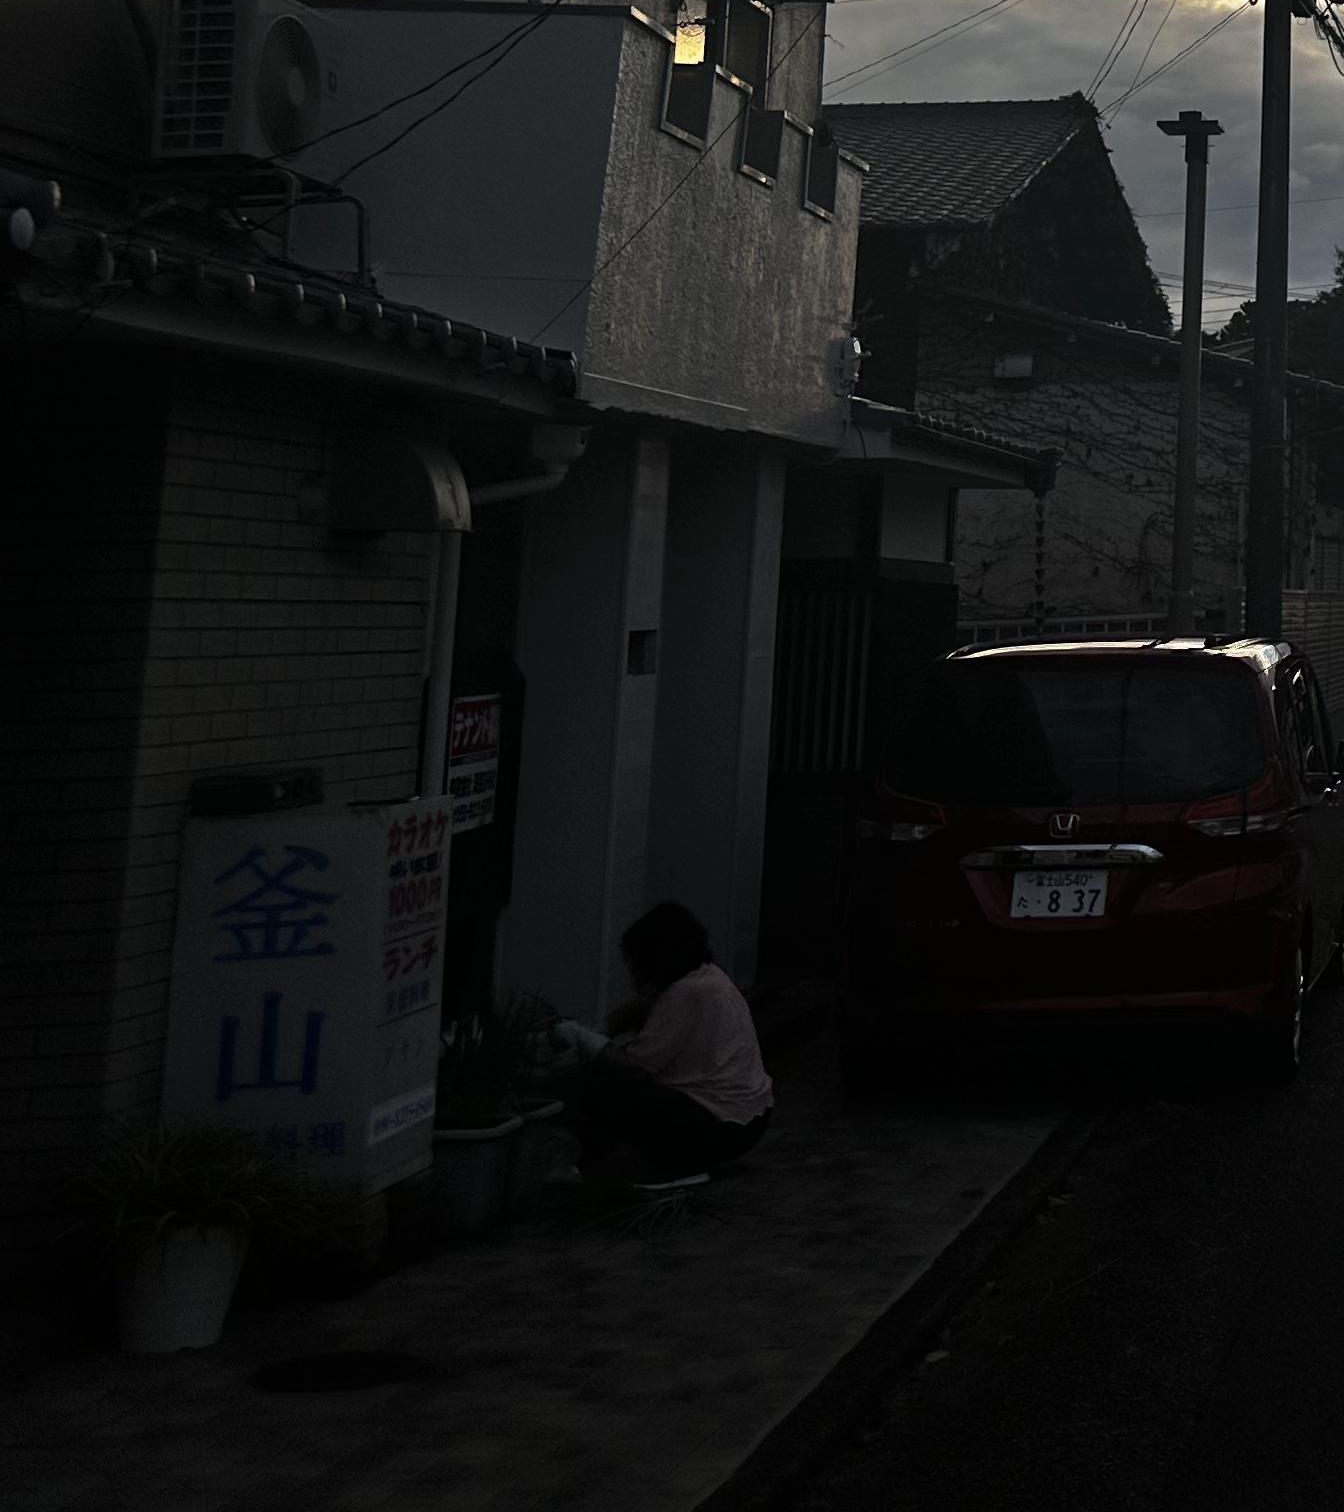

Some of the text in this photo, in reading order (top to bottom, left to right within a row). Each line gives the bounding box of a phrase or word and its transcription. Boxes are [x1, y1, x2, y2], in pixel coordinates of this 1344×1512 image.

[387, 808, 449, 856] カラオケ
[210, 843, 340, 1104] 釜山
[383, 935, 439, 981] ランチ
